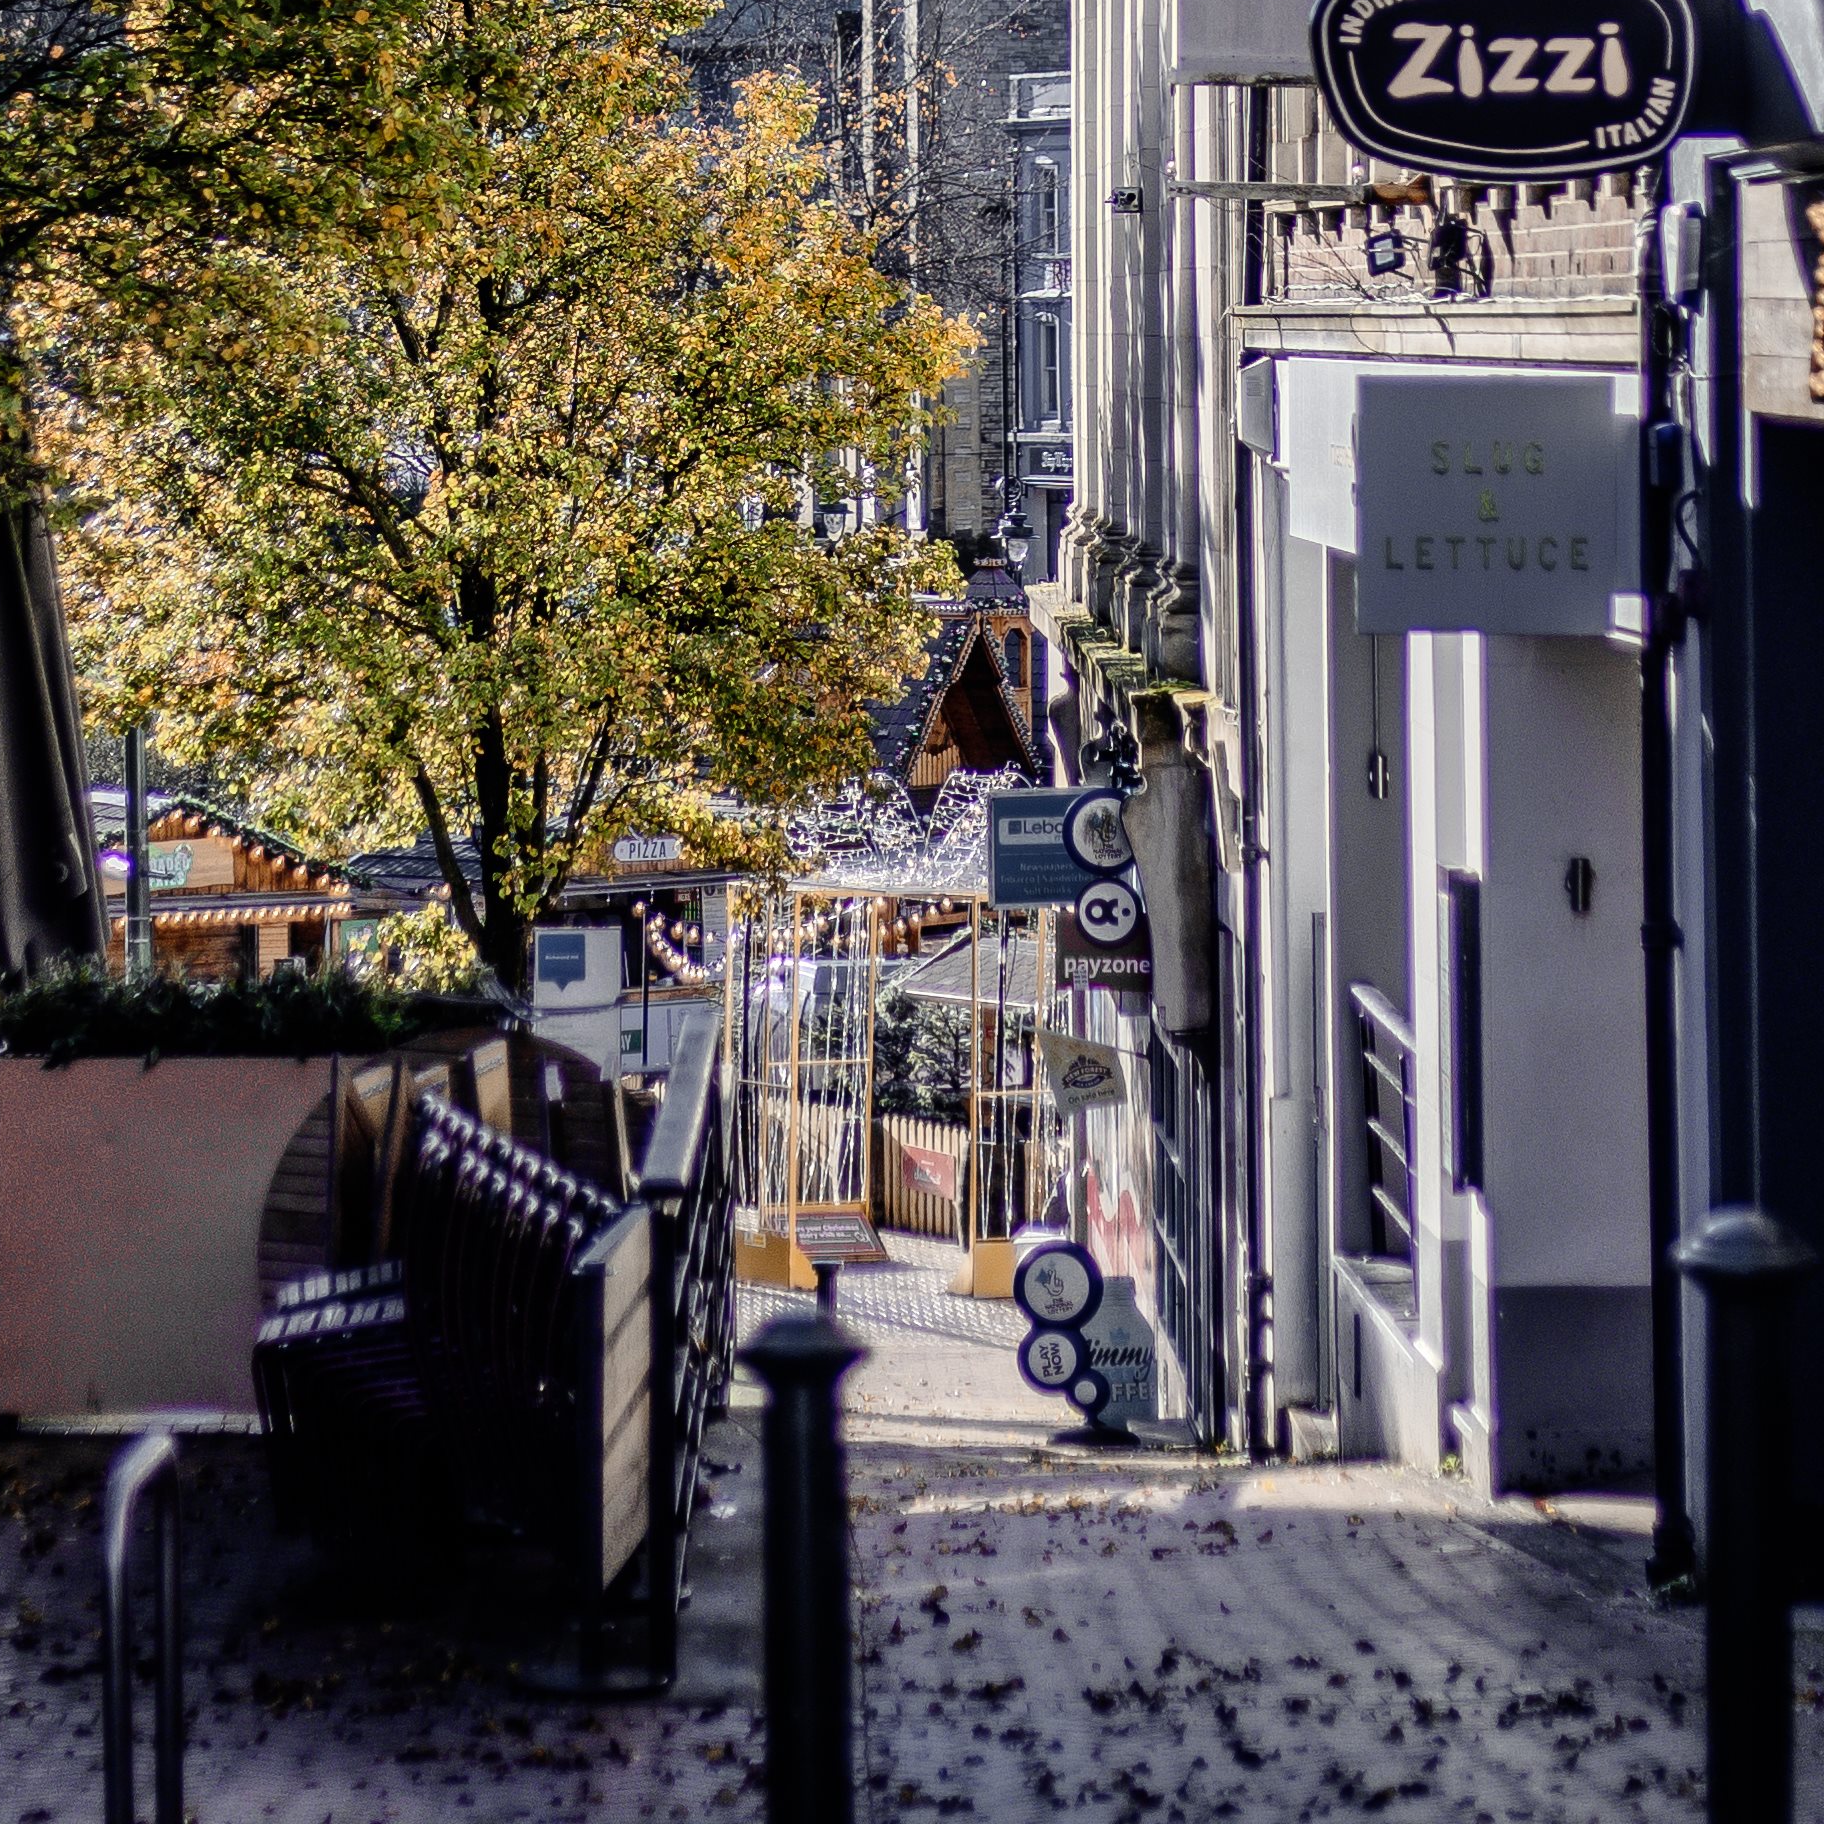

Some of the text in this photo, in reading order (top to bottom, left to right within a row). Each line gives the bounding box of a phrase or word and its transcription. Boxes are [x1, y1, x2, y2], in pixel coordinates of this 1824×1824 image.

[1386, 21, 1629, 99] Zizzi
[1594, 76, 1677, 149] ITALIAN
[1430, 439, 1545, 475] SLUG
[1383, 535, 1590, 572] LETTUCE
[629, 841, 667, 859] PIZZA
[1064, 956, 1151, 978] payzone
[1038, 1344, 1053, 1378] PLAY
[1049, 1342, 1064, 1376] NOW
